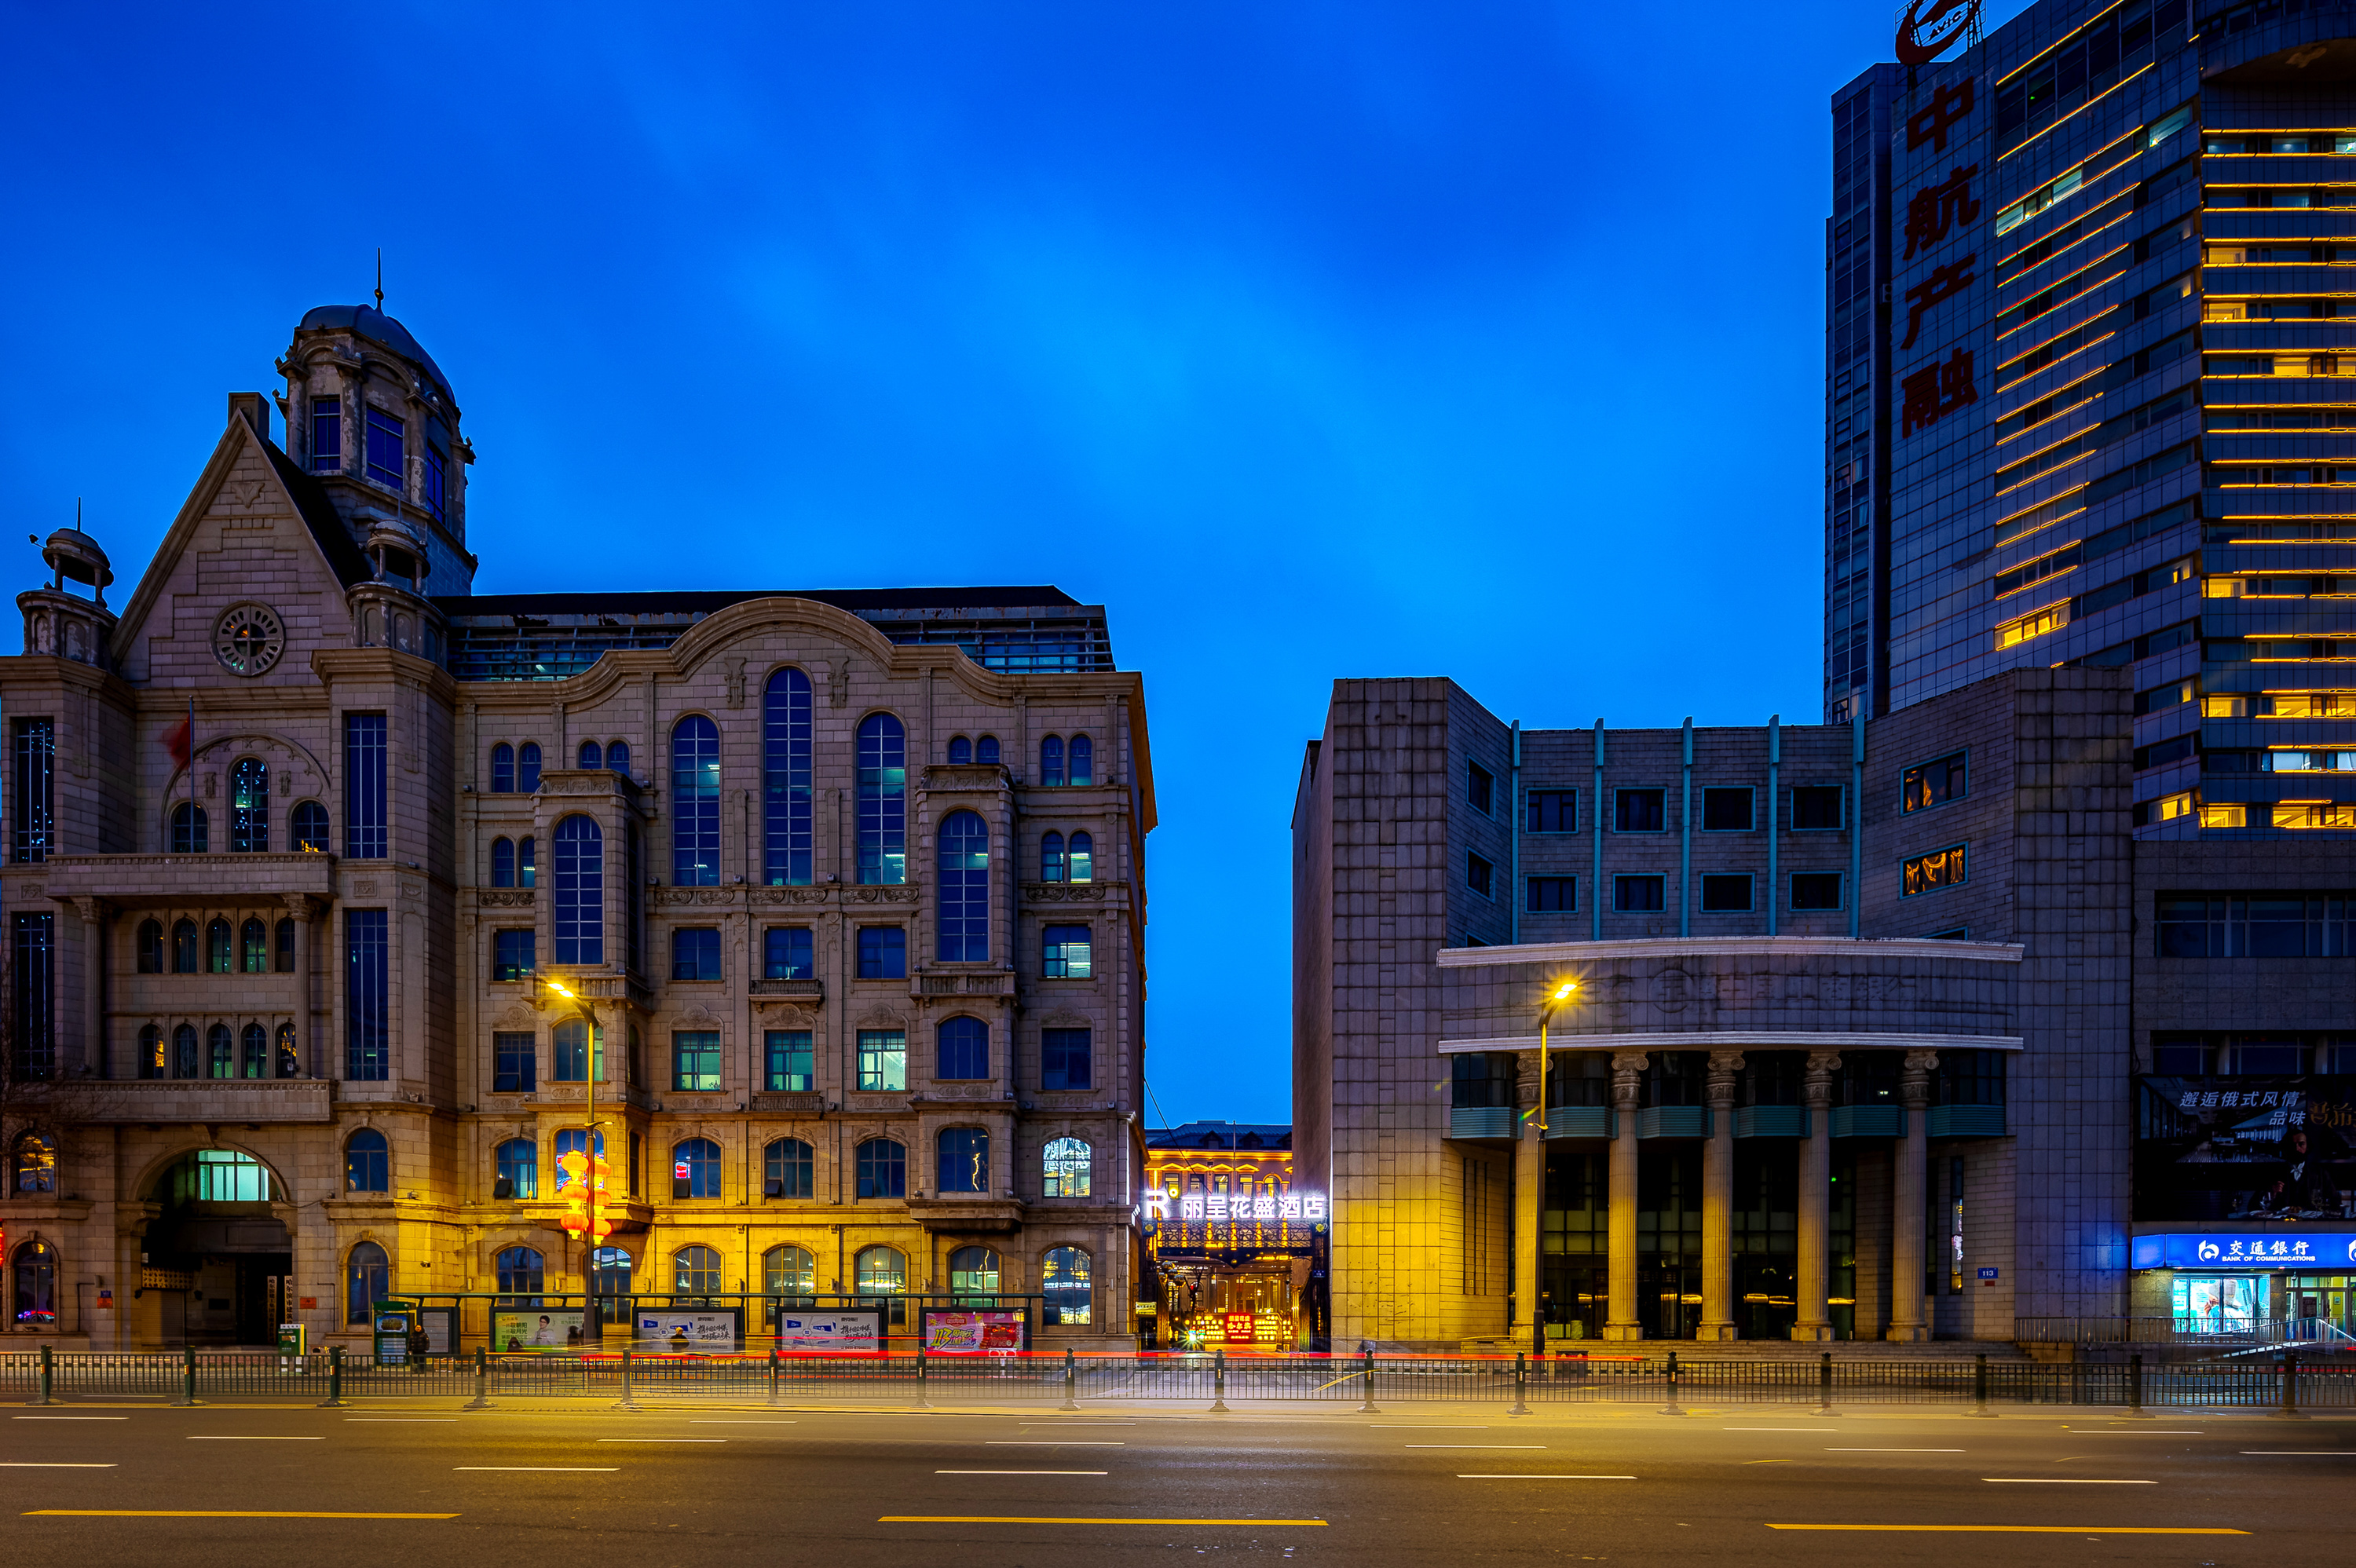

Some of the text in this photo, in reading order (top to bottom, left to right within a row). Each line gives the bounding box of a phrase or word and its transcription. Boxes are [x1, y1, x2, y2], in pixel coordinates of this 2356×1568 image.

[1930, 10, 1962, 40] AVIC
[1901, 75, 1981, 439] 中航产融
[2179, 1091, 2299, 1107] 邂逅俄式风情
[2269, 1111, 2306, 1125] 品味
[2310, 1101, 2356, 1128] 普希
[1181, 1195, 1326, 1219] 丽呈花盛酒店
[2229, 1240, 2310, 1256] 交通銀行
